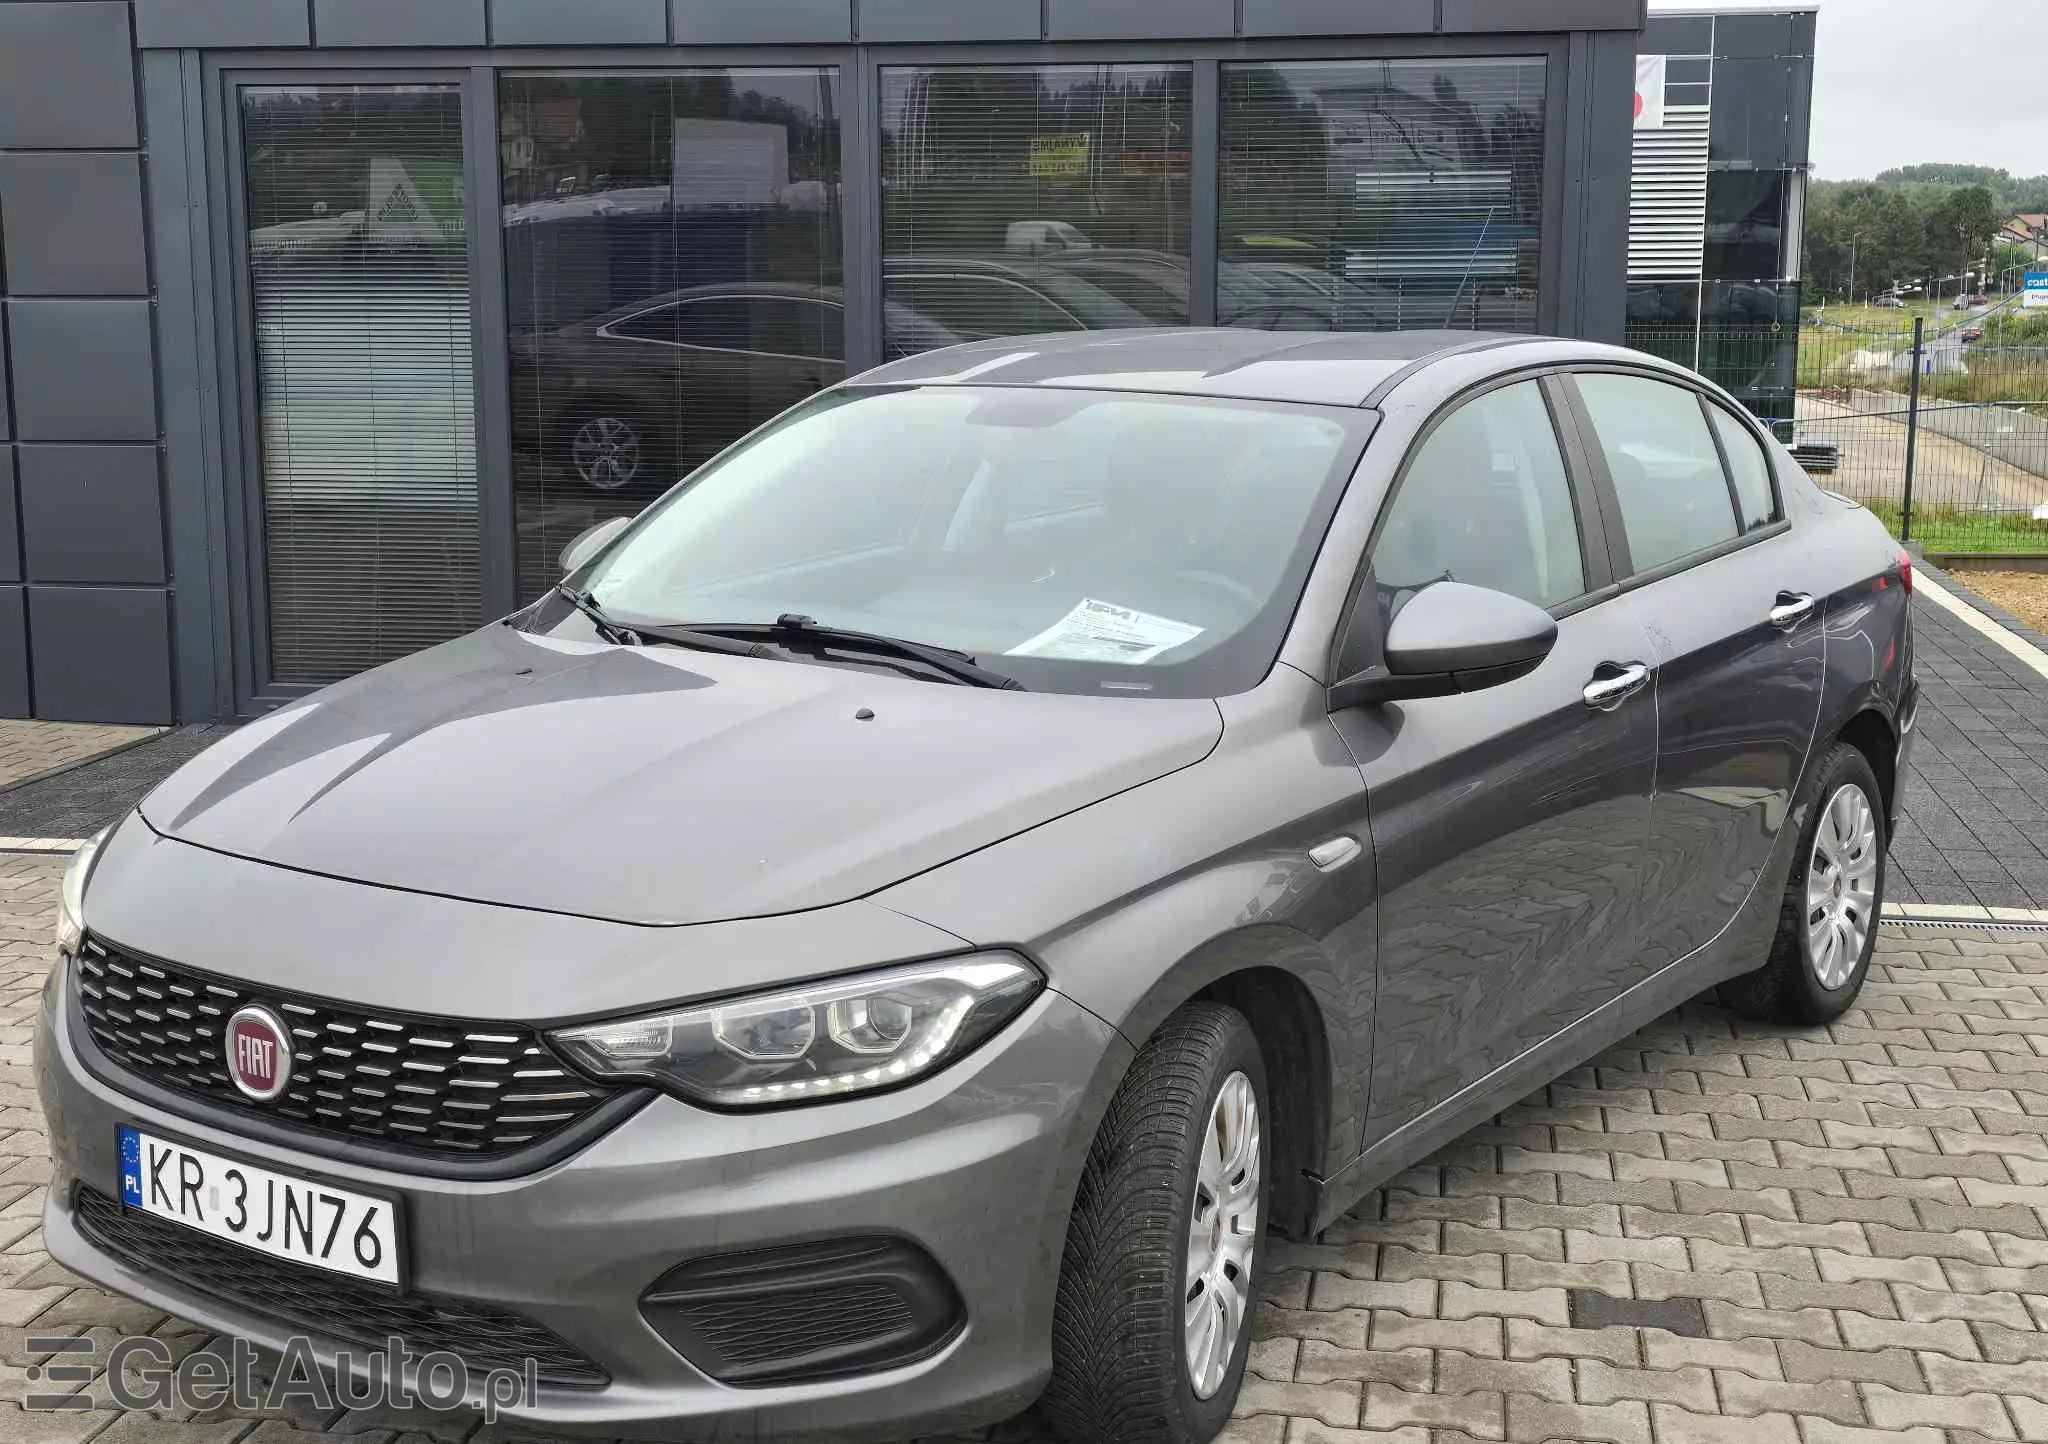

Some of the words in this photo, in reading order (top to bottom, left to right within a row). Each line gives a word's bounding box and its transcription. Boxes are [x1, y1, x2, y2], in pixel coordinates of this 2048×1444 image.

[238, 1033, 273, 1079] FIAT
[125, 1174, 140, 1194] PL
[150, 1144, 204, 1221] KR
[225, 1169, 382, 1269] 3JN76
